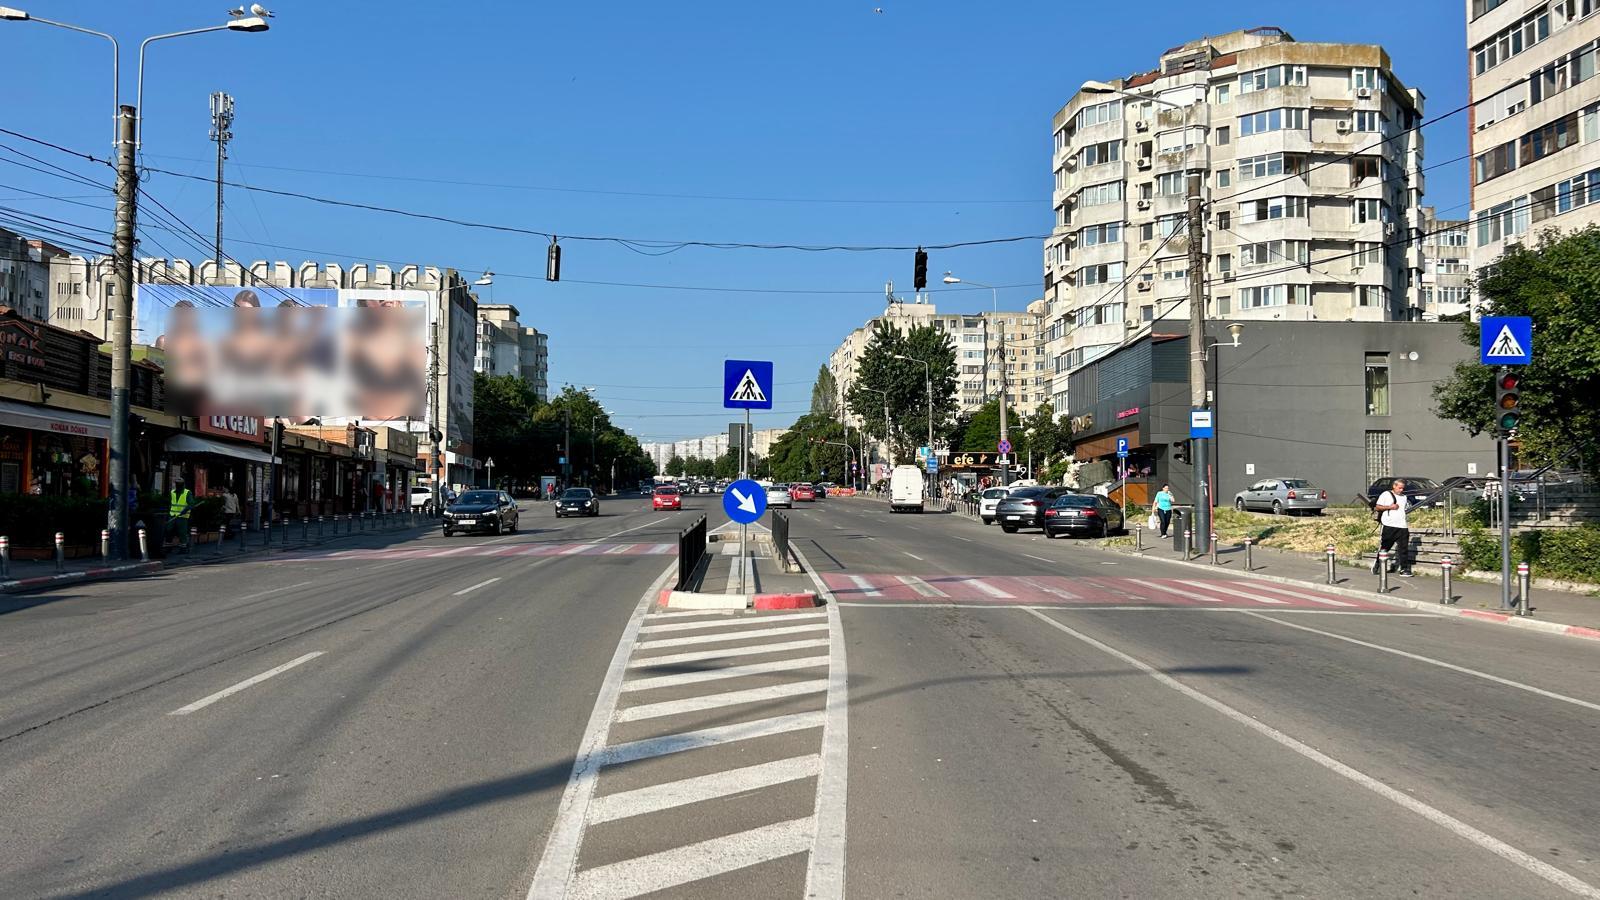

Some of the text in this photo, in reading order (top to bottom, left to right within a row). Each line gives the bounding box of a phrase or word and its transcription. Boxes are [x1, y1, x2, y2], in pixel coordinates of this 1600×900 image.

[211, 416, 258, 436] LA GEAM
[1119, 439, 1126, 452] P
[954, 453, 974, 465] efe
